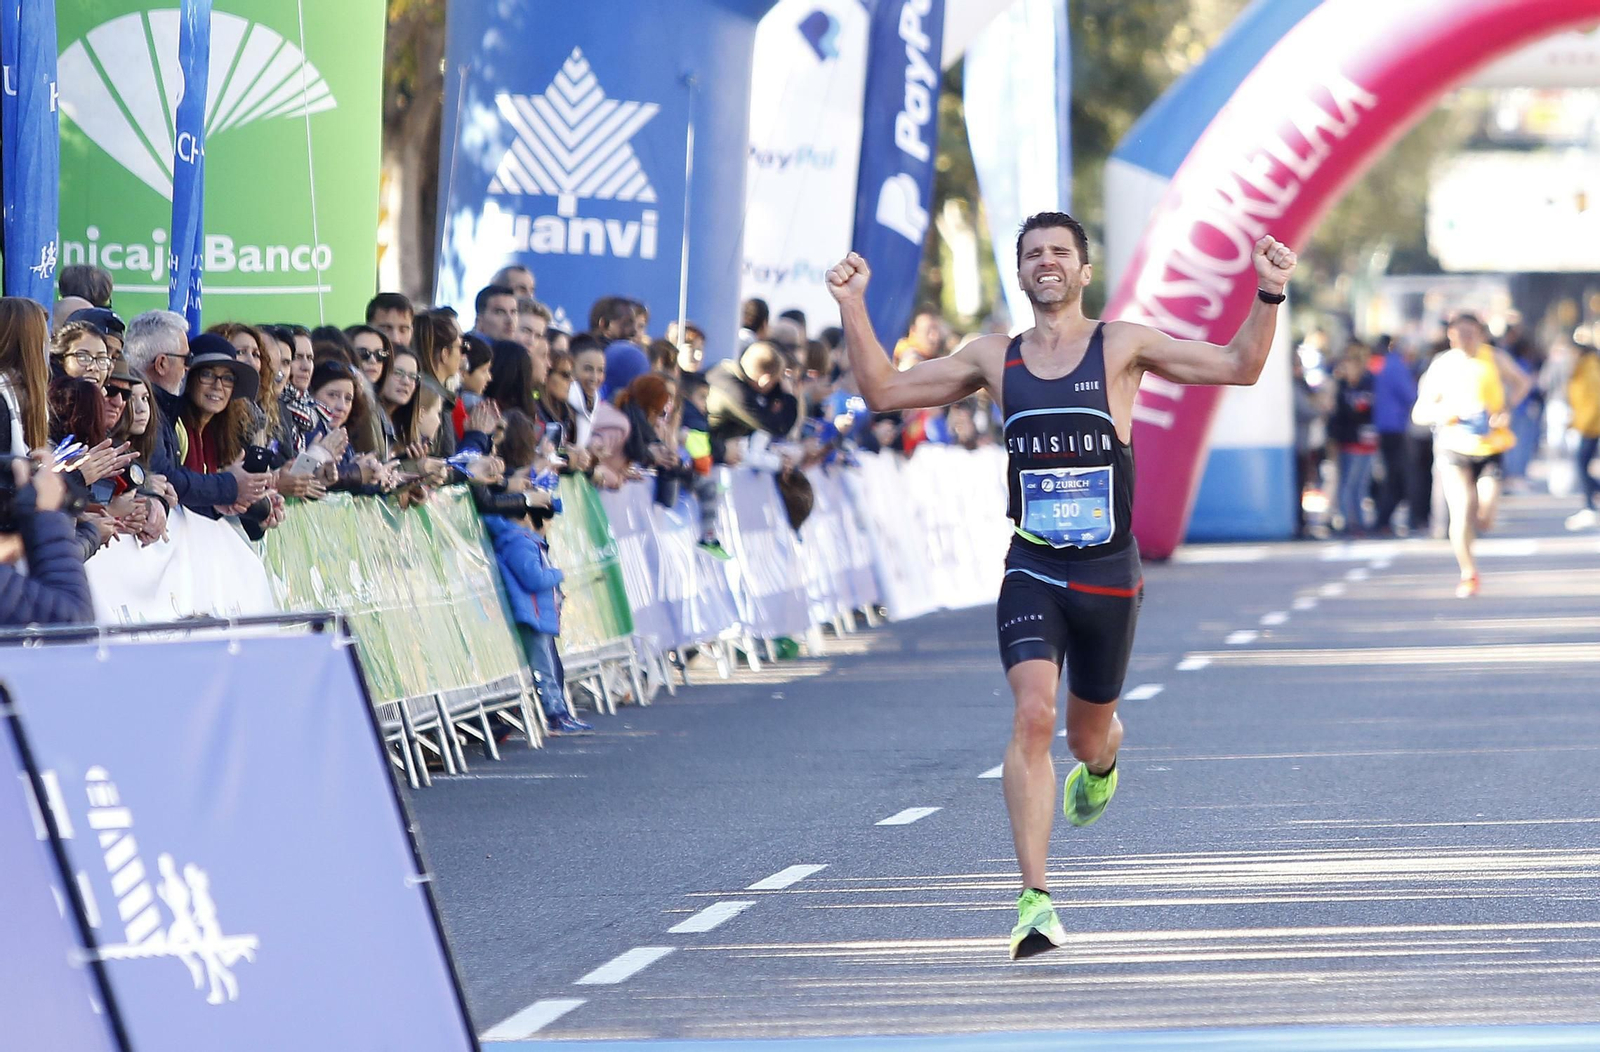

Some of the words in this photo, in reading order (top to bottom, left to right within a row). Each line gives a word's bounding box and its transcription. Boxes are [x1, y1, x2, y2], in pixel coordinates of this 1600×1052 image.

[483, 202, 658, 260] uanvi
[57, 225, 172, 281] nicaj
[204, 235, 332, 272] Banco
[1008, 433, 1113, 454] EVASION
[1055, 479, 1090, 489] ZURICH
[1052, 502, 1080, 518] 500
